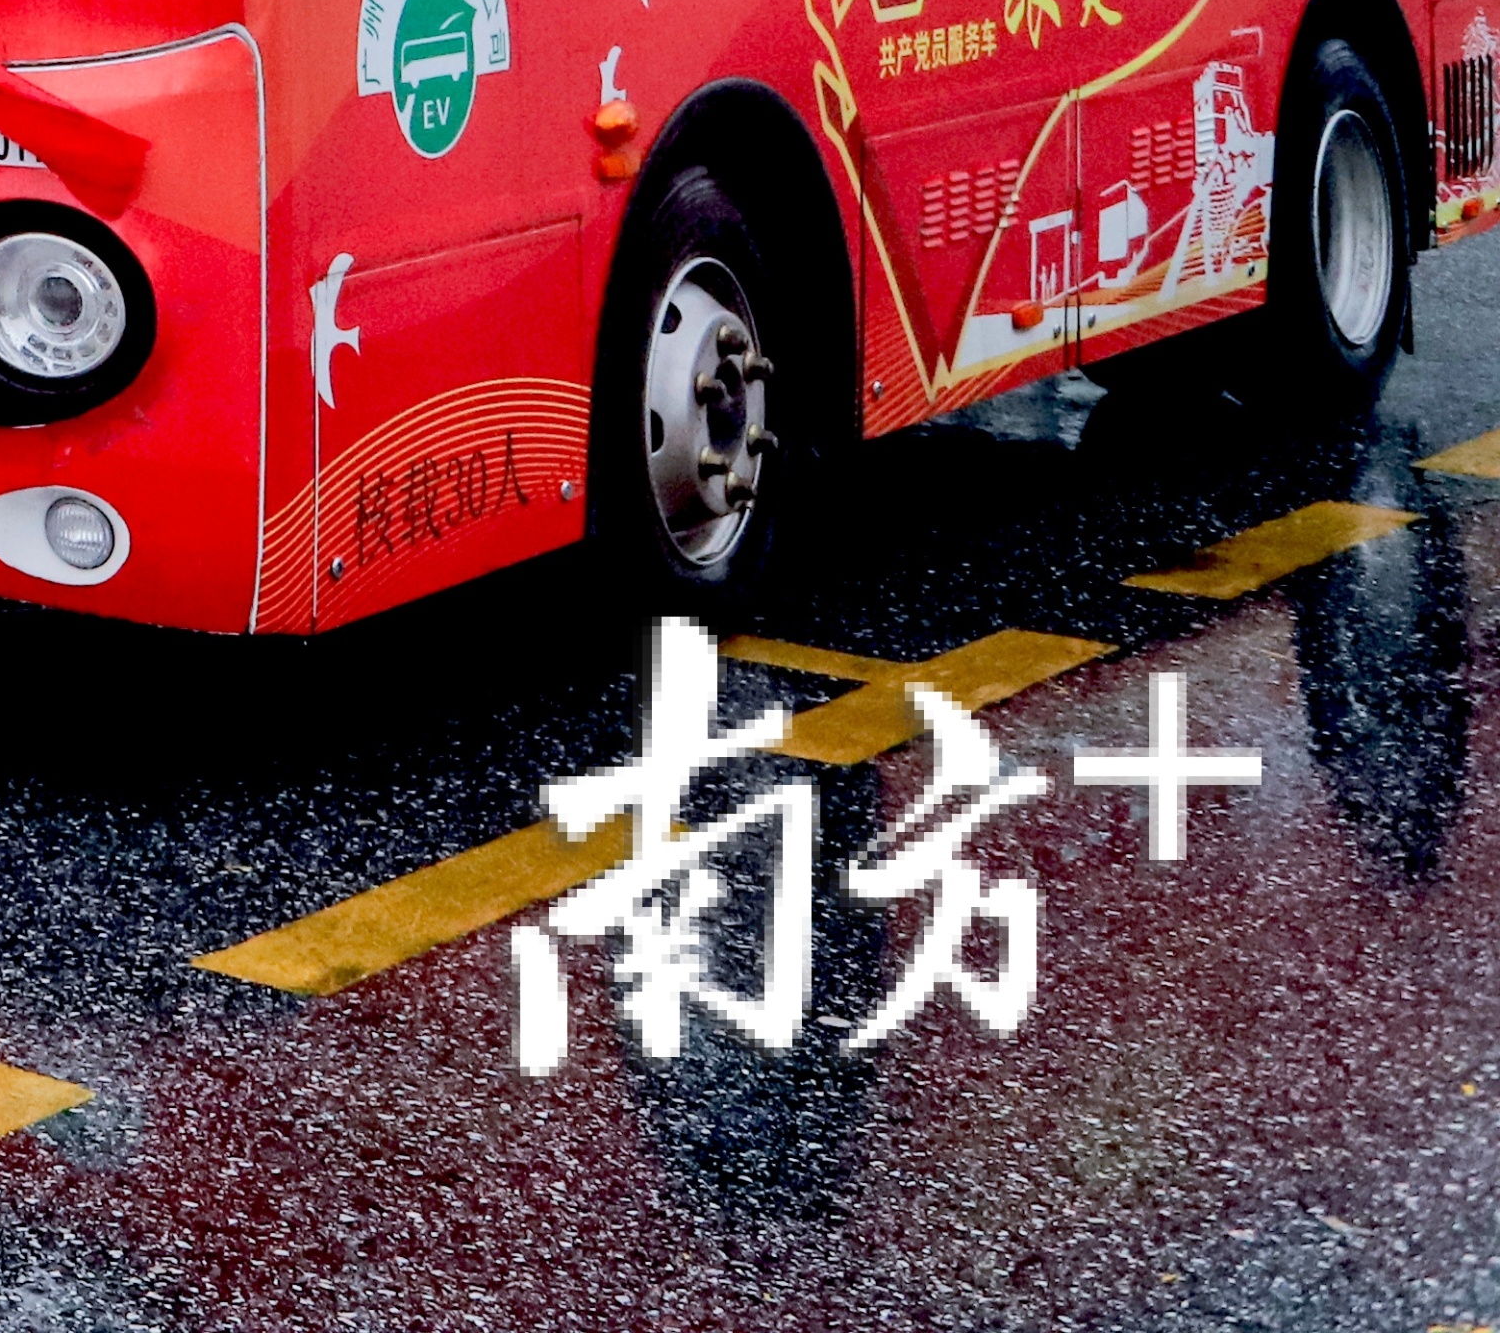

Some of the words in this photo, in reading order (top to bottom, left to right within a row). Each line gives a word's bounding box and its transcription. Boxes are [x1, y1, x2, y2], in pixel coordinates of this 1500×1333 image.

[878, 18, 998, 80] 共产党员服务车
[422, 95, 452, 130] EV
